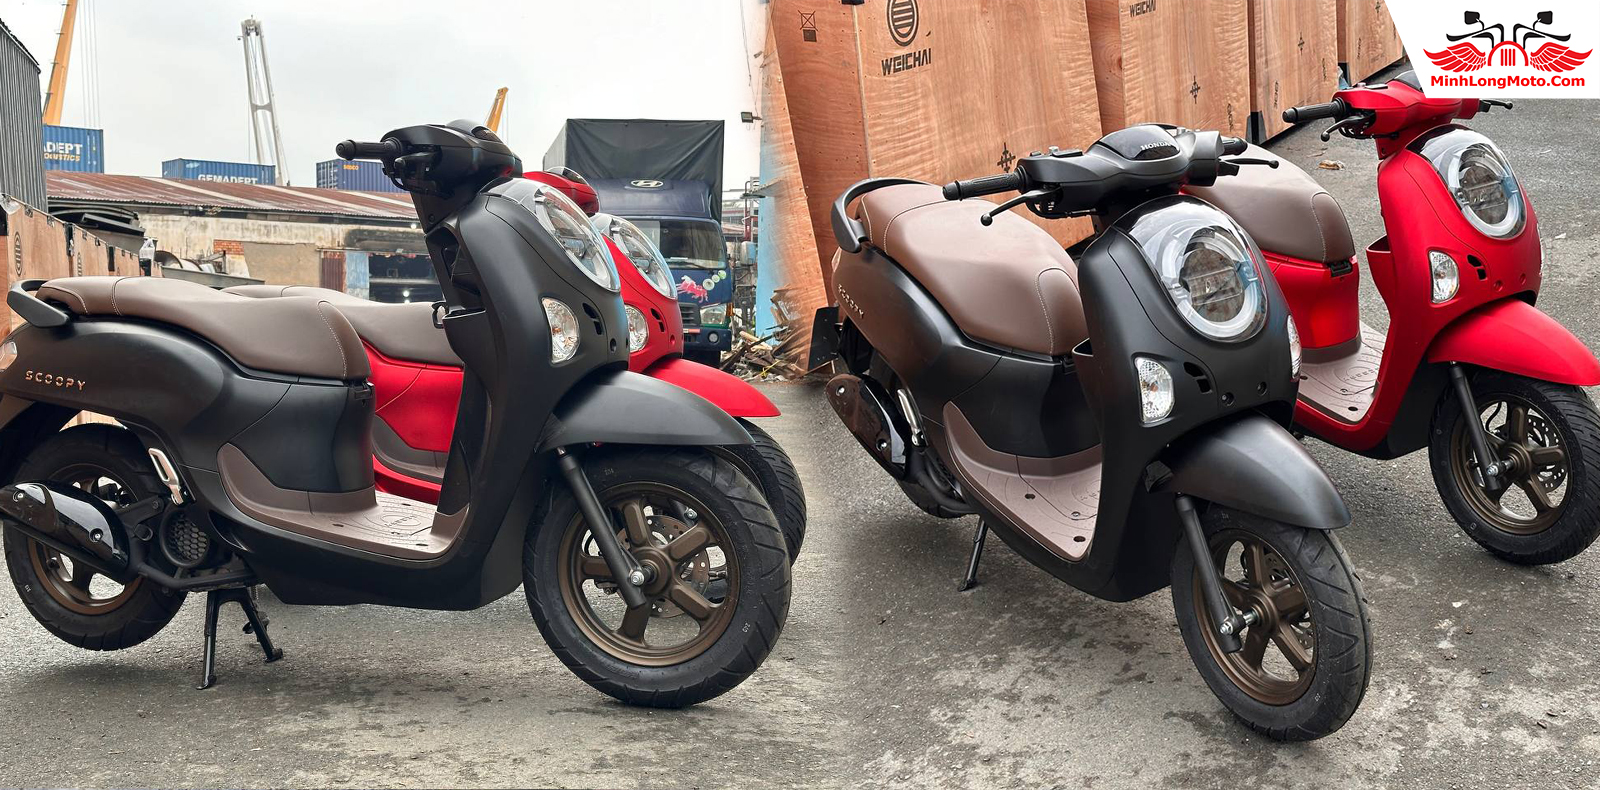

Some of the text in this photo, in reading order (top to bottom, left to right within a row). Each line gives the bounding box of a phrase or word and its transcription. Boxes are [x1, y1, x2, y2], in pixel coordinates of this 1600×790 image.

[1130, 0, 1157, 18] WEICHAI
[881, 47, 932, 77] WEICHAI
[1140, 141, 1172, 151] HONDA
[197, 174, 258, 186] GEMADEPT
[25, 370, 86, 391] SCOOPY
